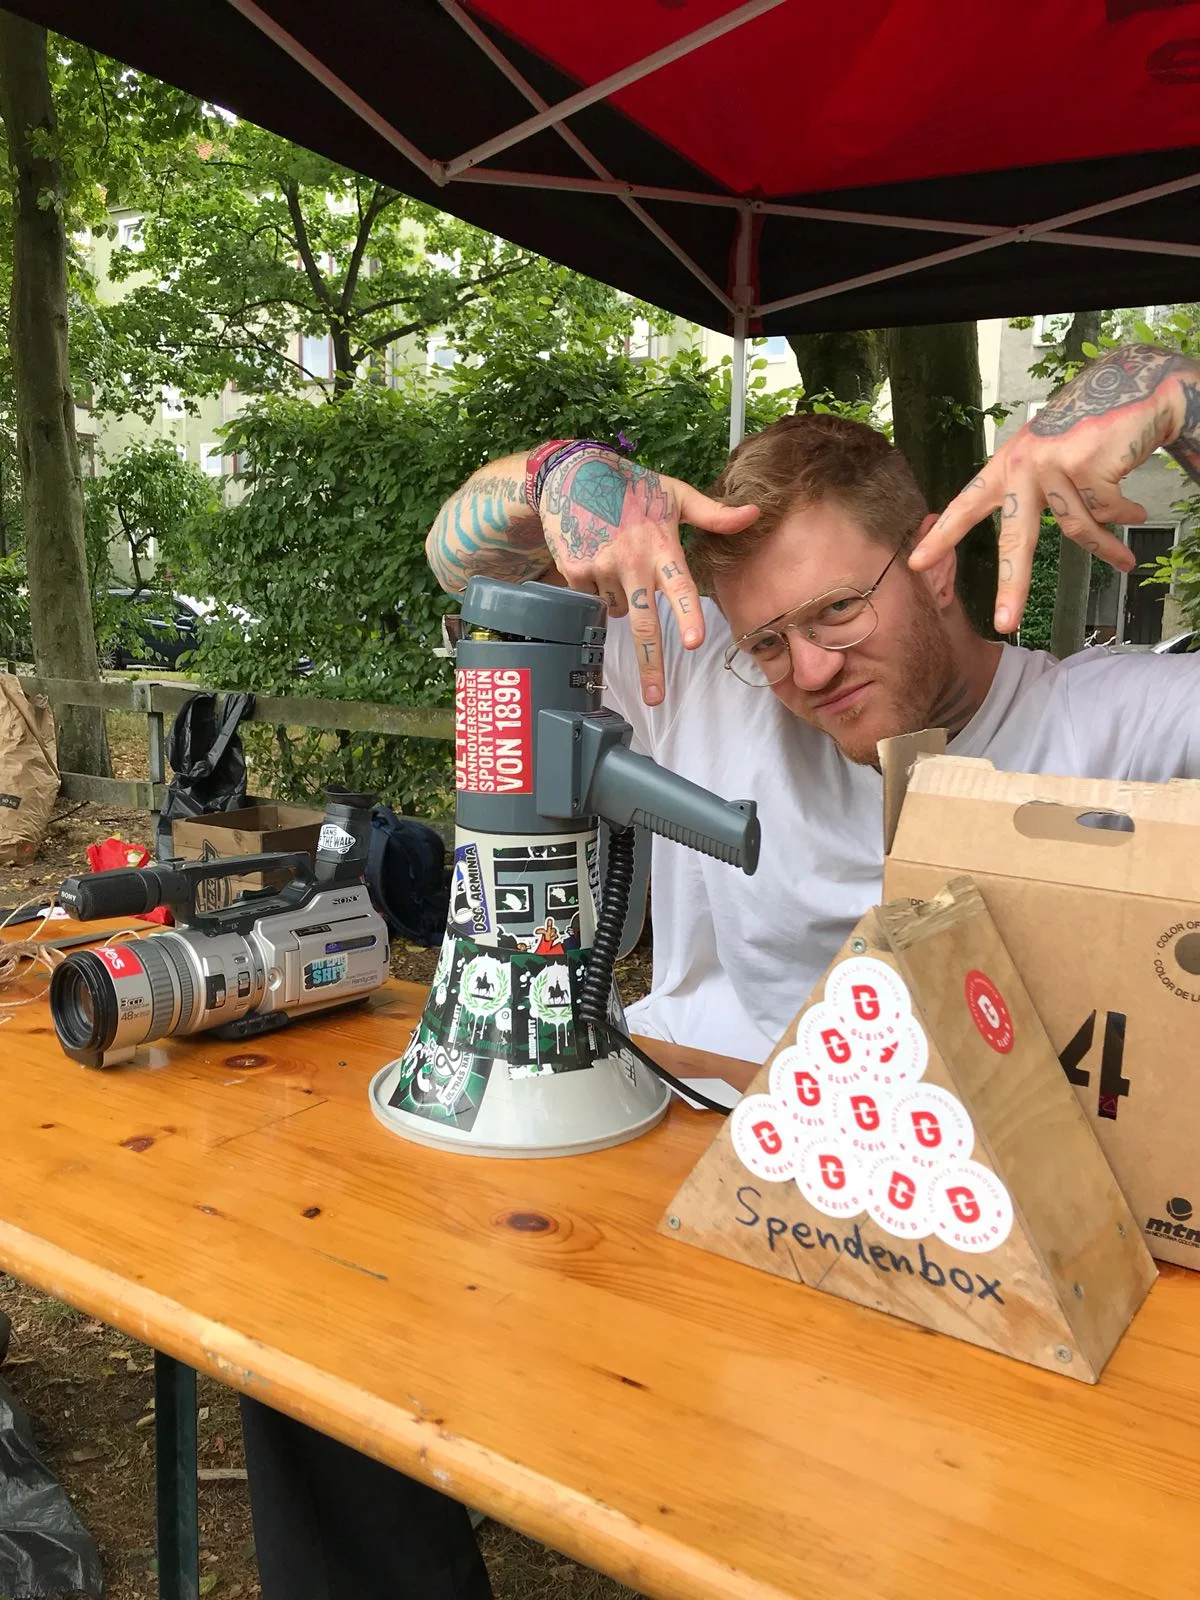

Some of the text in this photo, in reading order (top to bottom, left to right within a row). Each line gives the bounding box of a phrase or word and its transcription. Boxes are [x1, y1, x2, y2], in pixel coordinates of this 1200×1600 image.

[466, 670, 477, 791] HANNOVERSCHER
[477, 670, 495, 792] SPORTVEREIN
[493, 670, 524, 792] VON 1896
[60, 890, 76, 902] SONY
[332, 895, 360, 905] SONY
[465, 845, 487, 933] DSC ARMINIA
[1156, 923, 1185, 949] COLOR
[312, 965, 346, 985] SHIT
[1153, 959, 1176, 992] COLOR
[1174, 988, 1190, 1000] DE
[850, 1027, 885, 1042] GLEIS
[445, 1070, 466, 1103] ULTRAS
[735, 1185, 1006, 1305] Spendenbox
[953, 1232, 991, 1245] GLEIS
